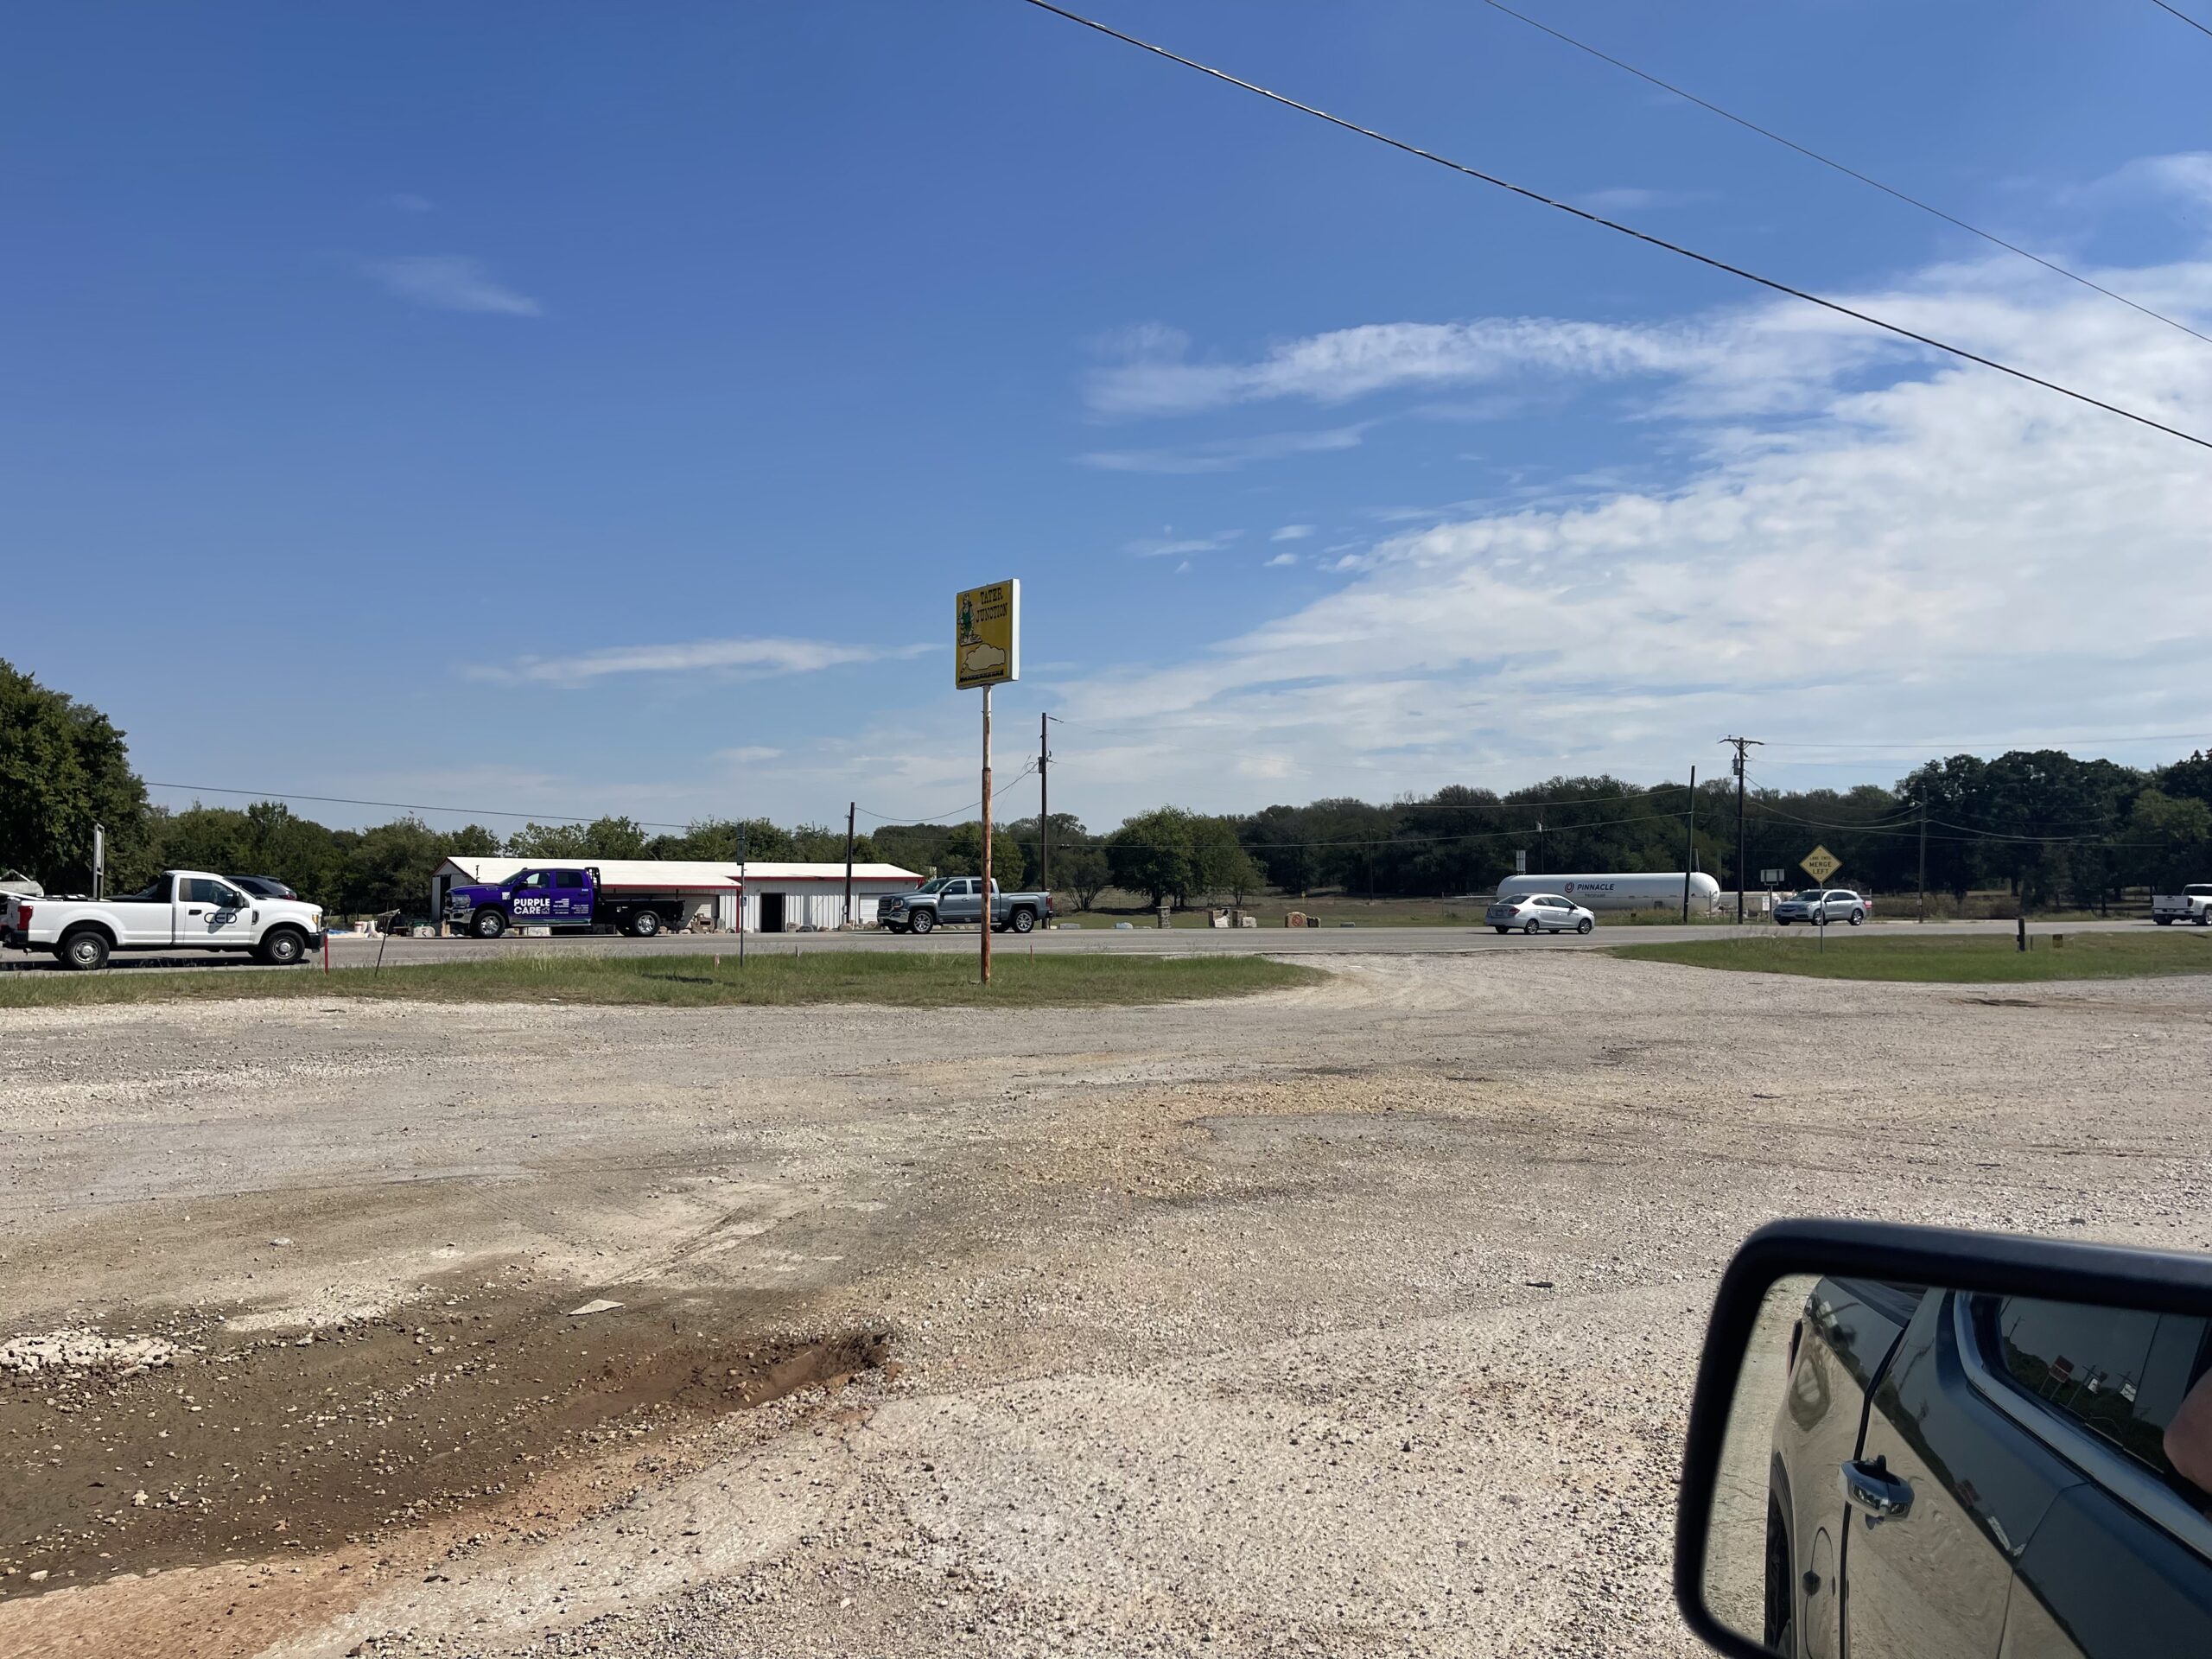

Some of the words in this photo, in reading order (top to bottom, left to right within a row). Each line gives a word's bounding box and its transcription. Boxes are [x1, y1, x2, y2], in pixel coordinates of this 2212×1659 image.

[980, 588, 1003, 605] TATER
[976, 603, 1007, 623] JUNCTION
[513, 898, 550, 906] PURPLE
[204, 912, 238, 924] CED
